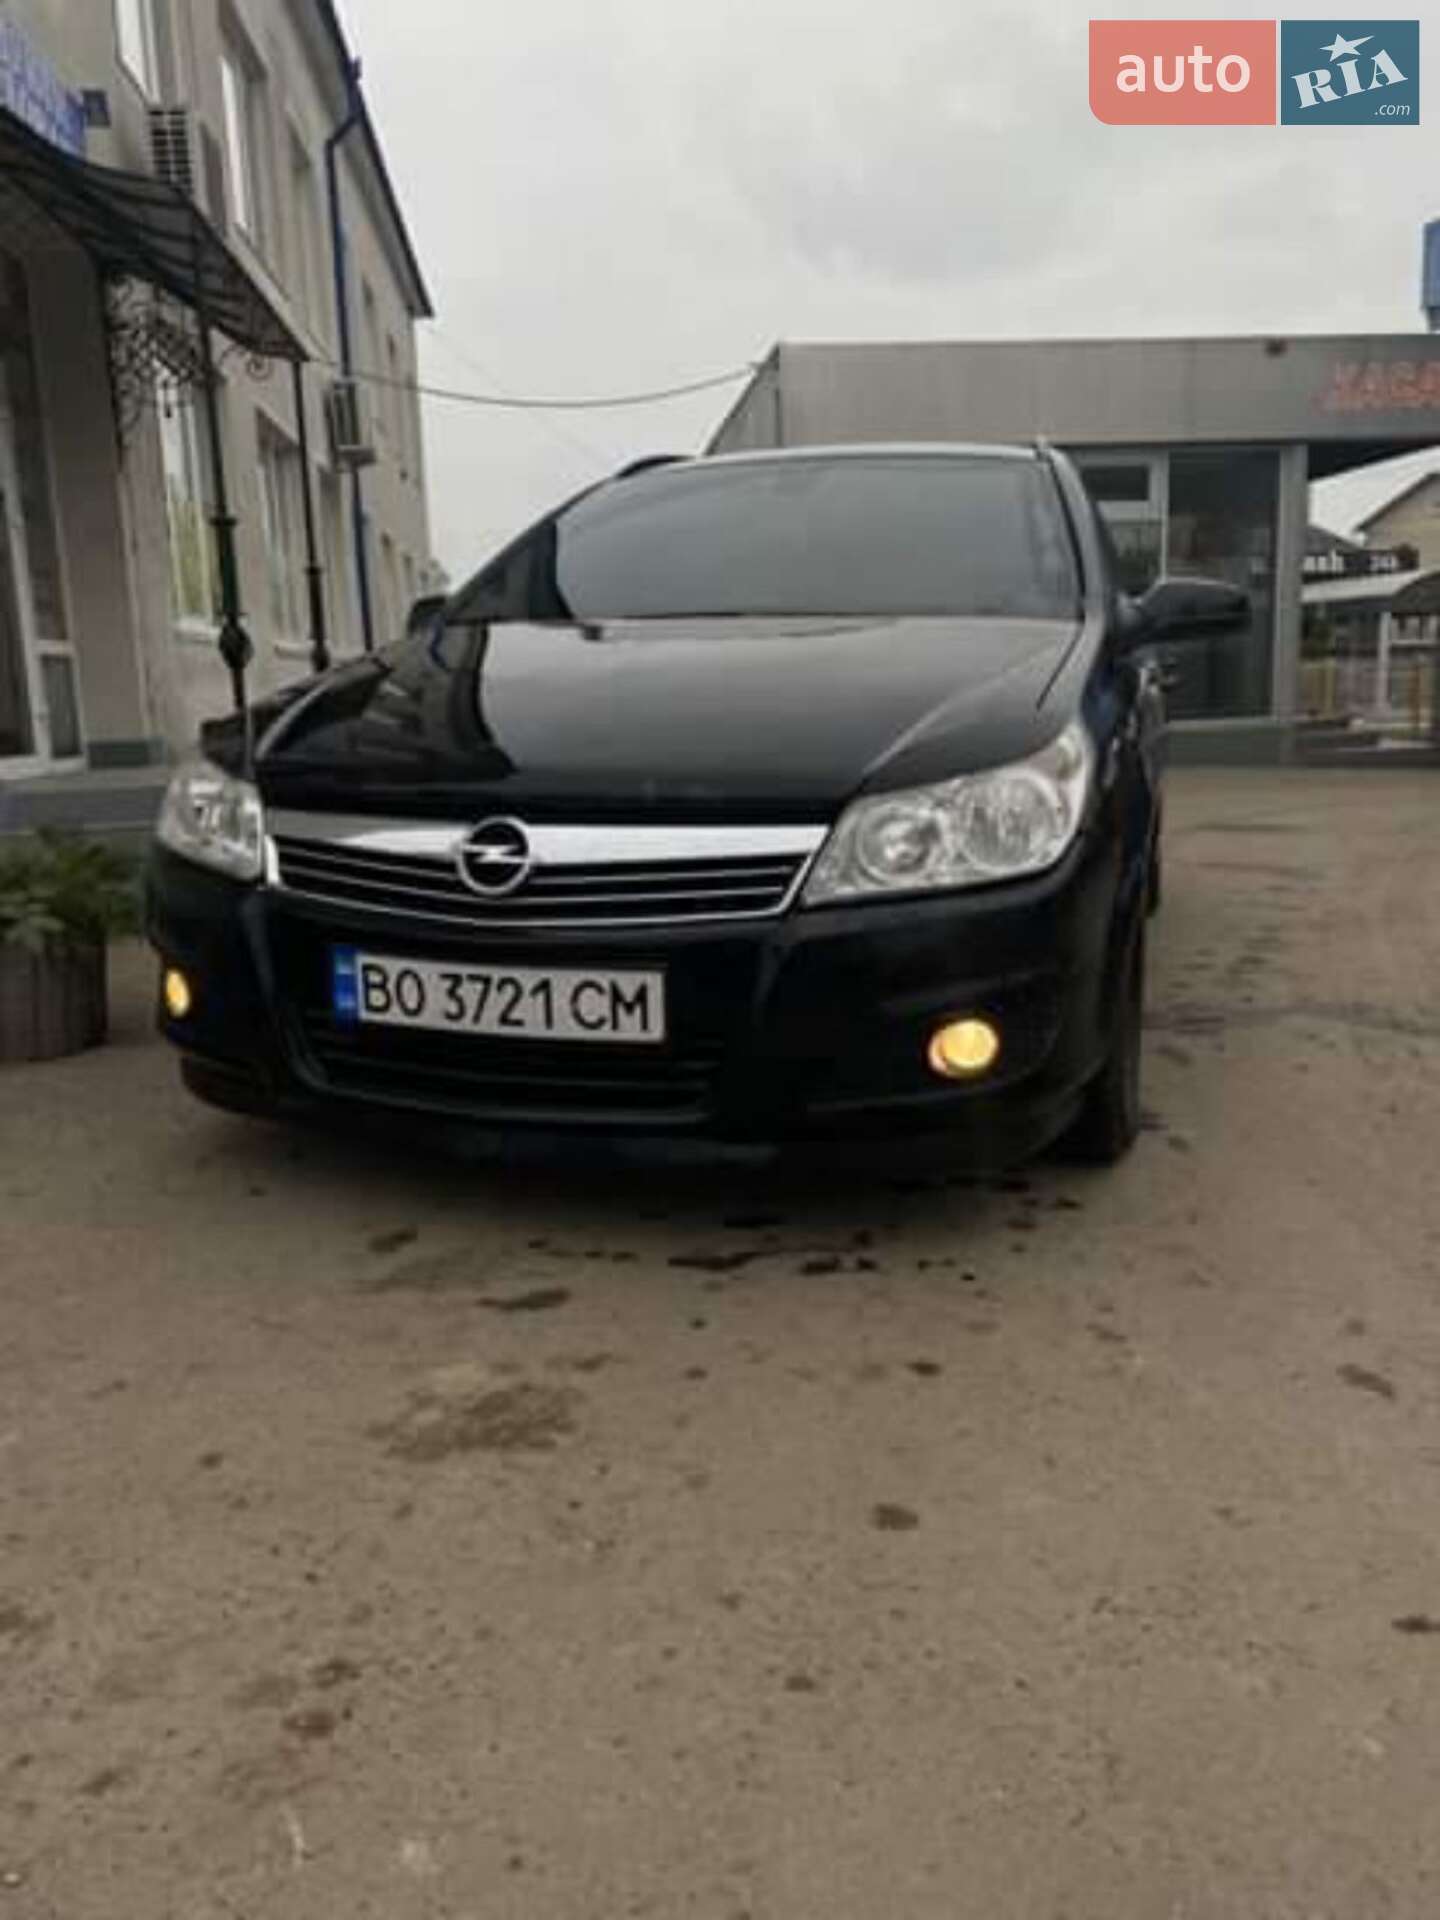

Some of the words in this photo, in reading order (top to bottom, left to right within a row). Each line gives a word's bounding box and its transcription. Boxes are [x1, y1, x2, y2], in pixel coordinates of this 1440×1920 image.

[361, 962, 426, 1017] BO
[439, 973, 555, 1031] 3721
[570, 979, 649, 1031] CM
